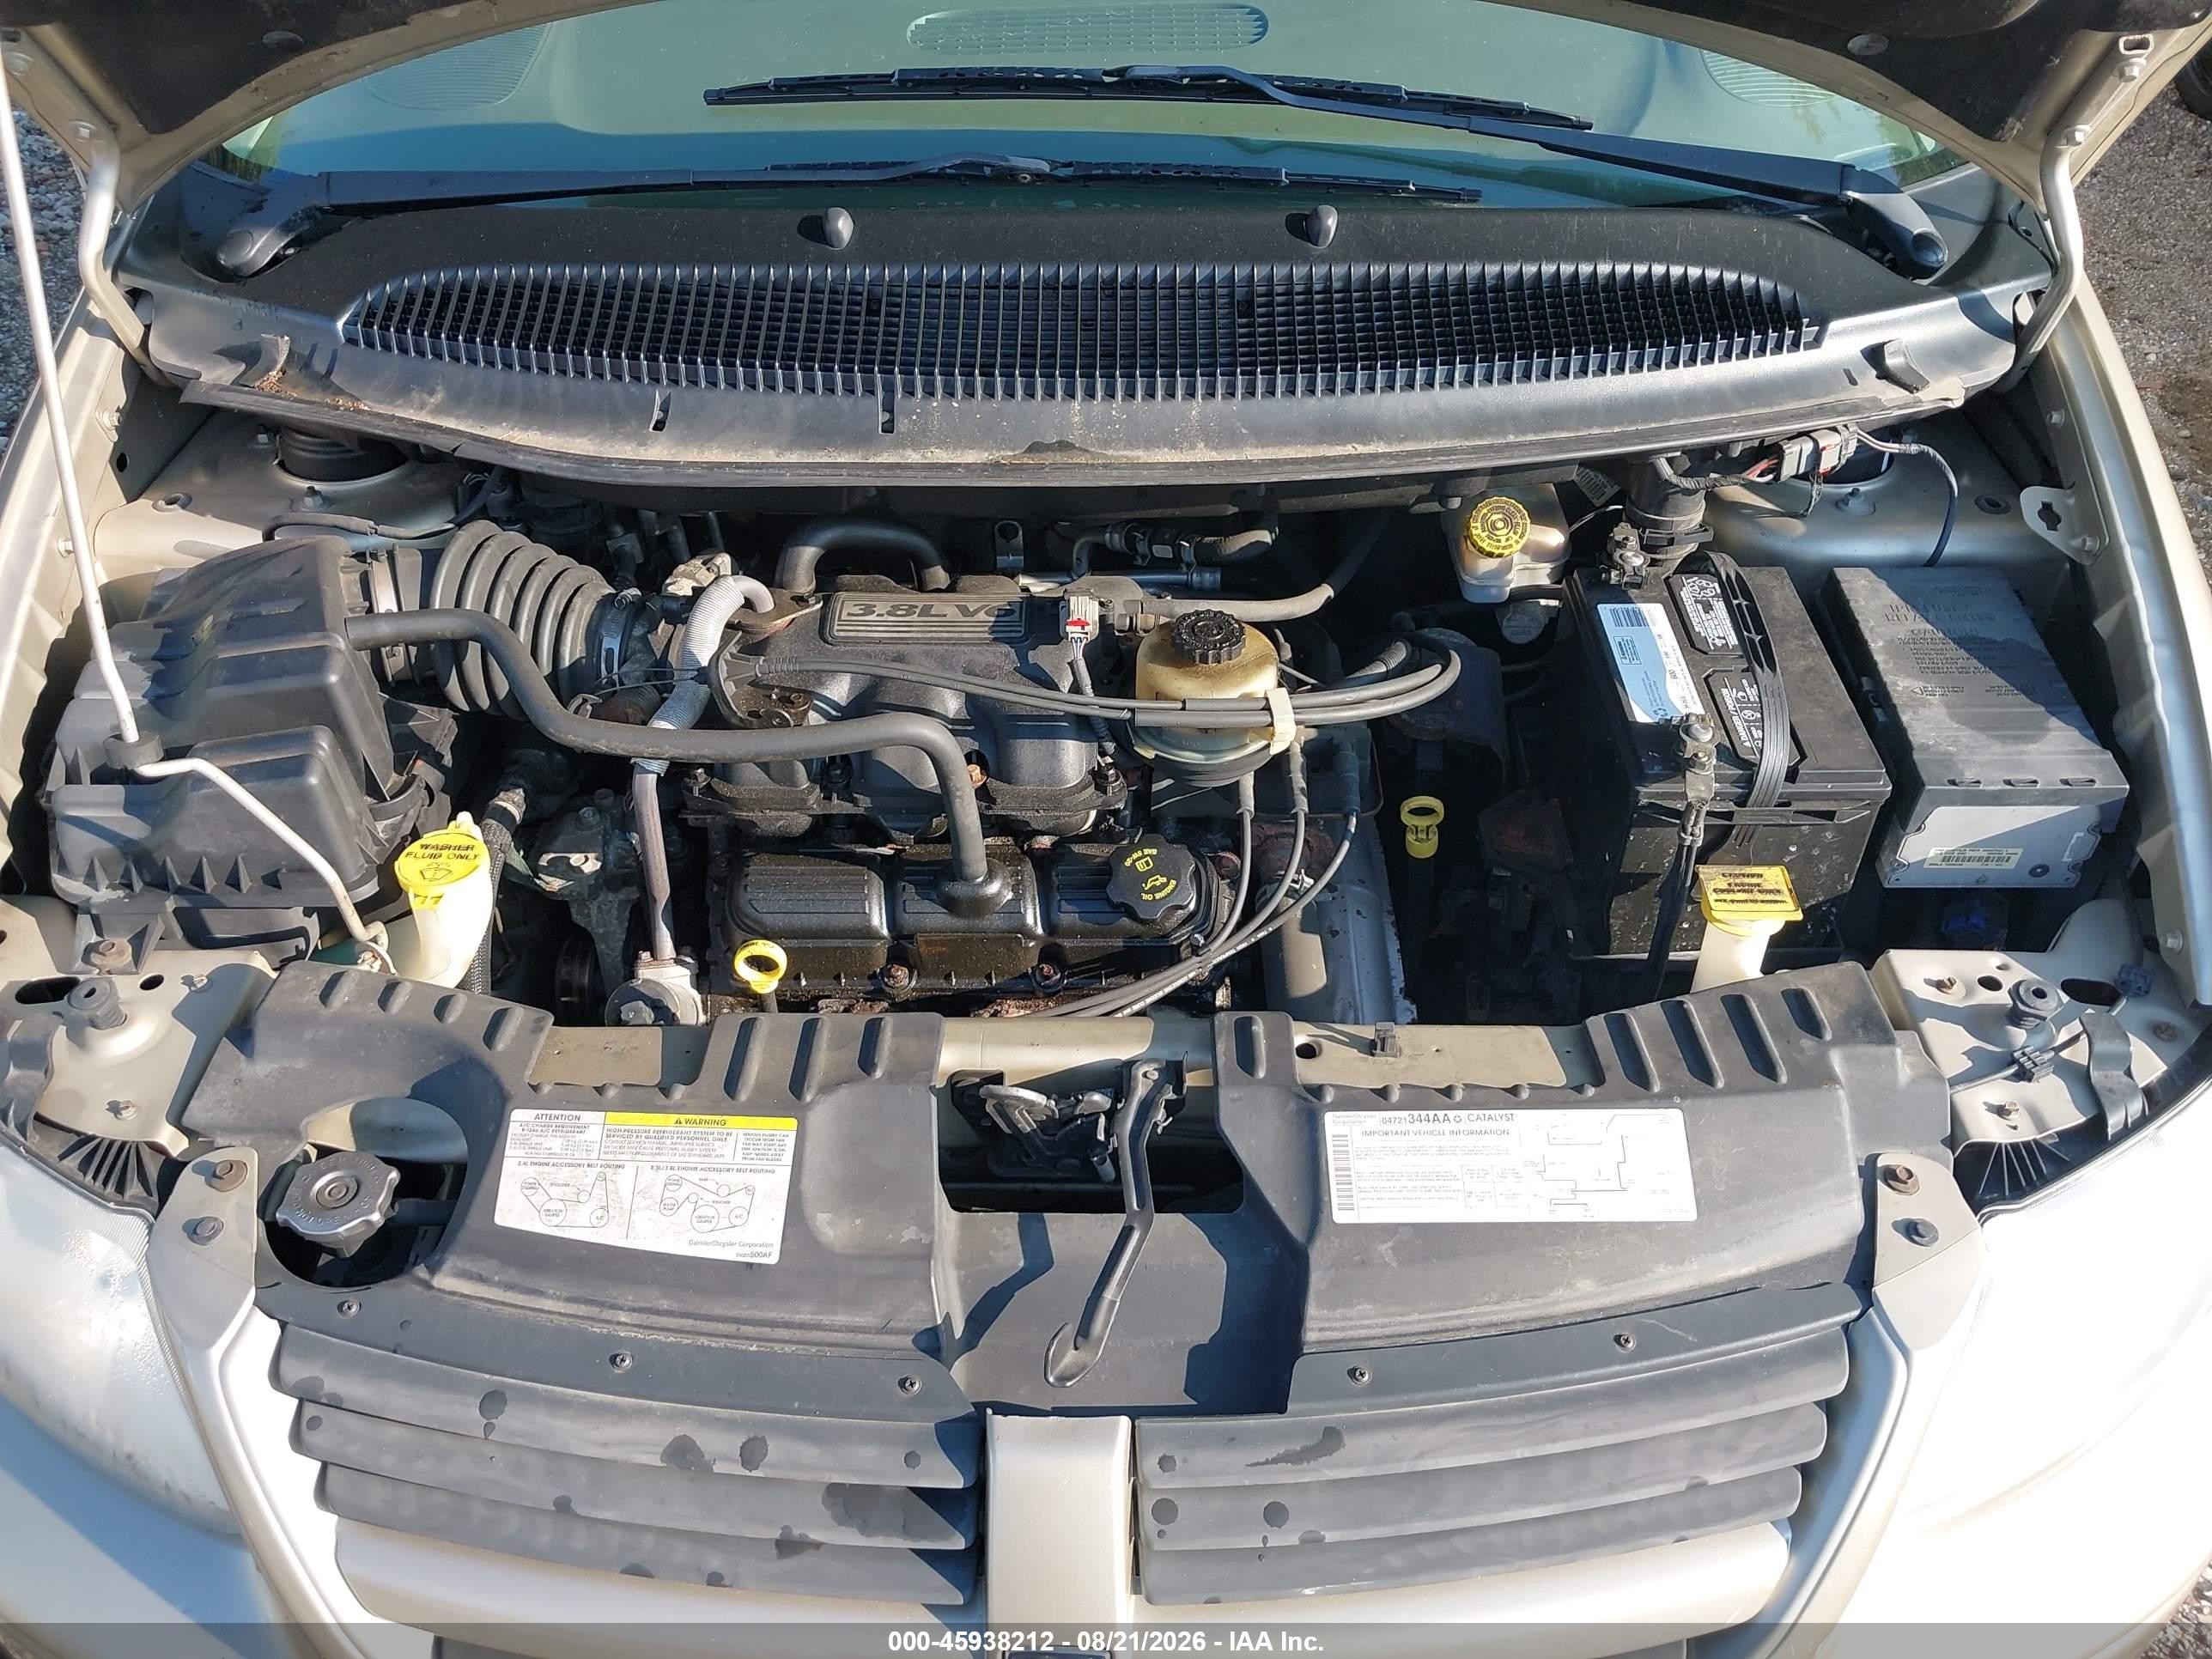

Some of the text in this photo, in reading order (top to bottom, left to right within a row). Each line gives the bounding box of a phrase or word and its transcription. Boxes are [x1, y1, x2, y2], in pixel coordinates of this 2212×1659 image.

[847, 603, 1016, 618] 3.8L V6
[1720, 688, 1736, 711] POISON
[1732, 715, 1749, 741] DANGER
[420, 843, 476, 852] WASHER
[405, 851, 442, 860] FLUID
[1140, 878, 1177, 901] ENGINE OIL
[534, 1113, 581, 1121] ATTENTION
[1467, 1113, 1516, 1122] CATALYST
[688, 1239, 737, 1249] DaimlerChrysler
